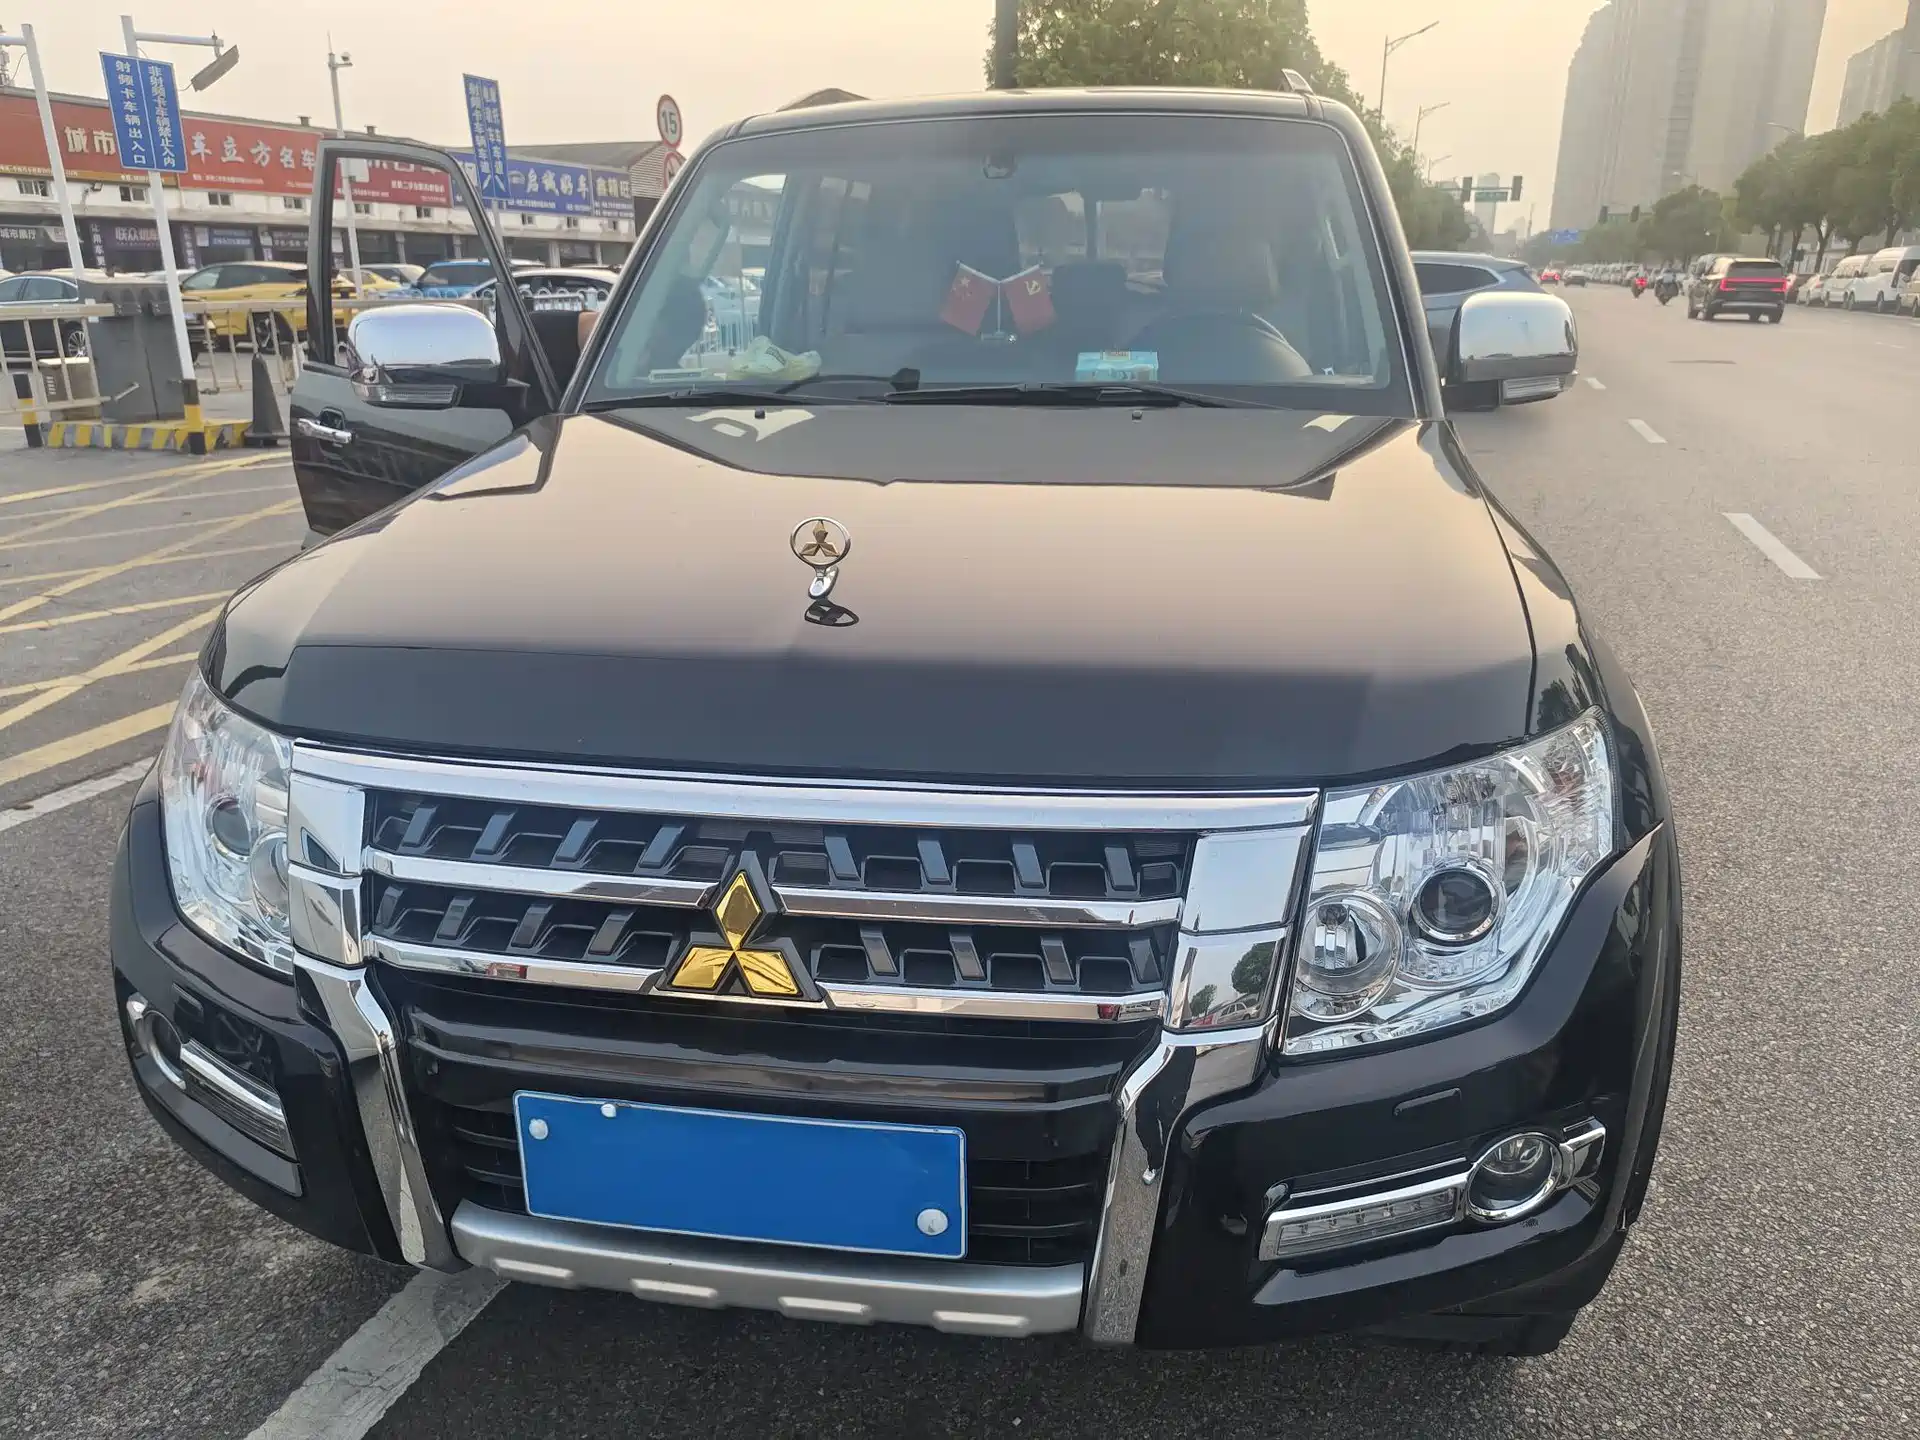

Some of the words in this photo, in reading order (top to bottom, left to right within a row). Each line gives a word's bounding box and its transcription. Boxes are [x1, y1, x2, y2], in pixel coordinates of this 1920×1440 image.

[115, 60, 146, 165] 射频卡车辆出入口
[661, 109, 678, 135] 15
[64, 126, 117, 156] 城市
